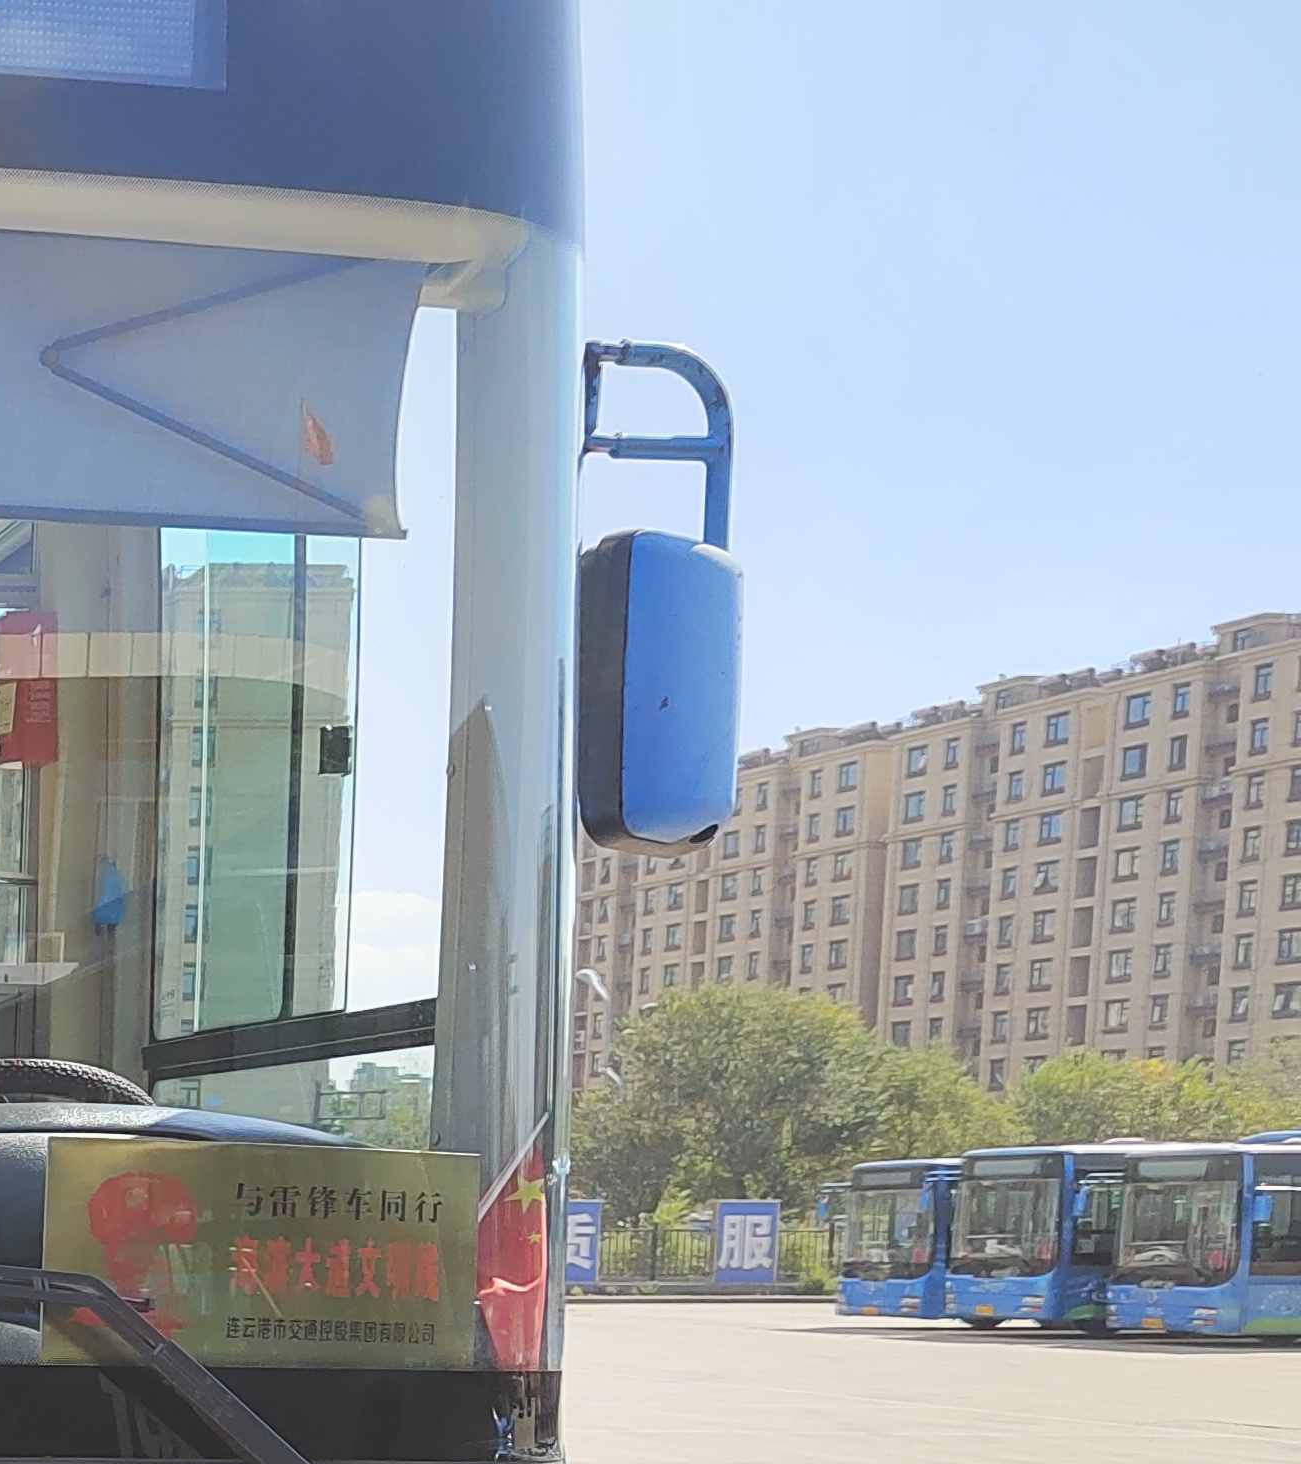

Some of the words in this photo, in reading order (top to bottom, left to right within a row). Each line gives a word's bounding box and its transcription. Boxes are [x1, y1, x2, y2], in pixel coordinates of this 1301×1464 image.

[231, 1182, 443, 1224] 与雷锋车同行
[717, 1214, 774, 1271] 服
[225, 1316, 436, 1346] 连云港市交通控股集团有限公司
